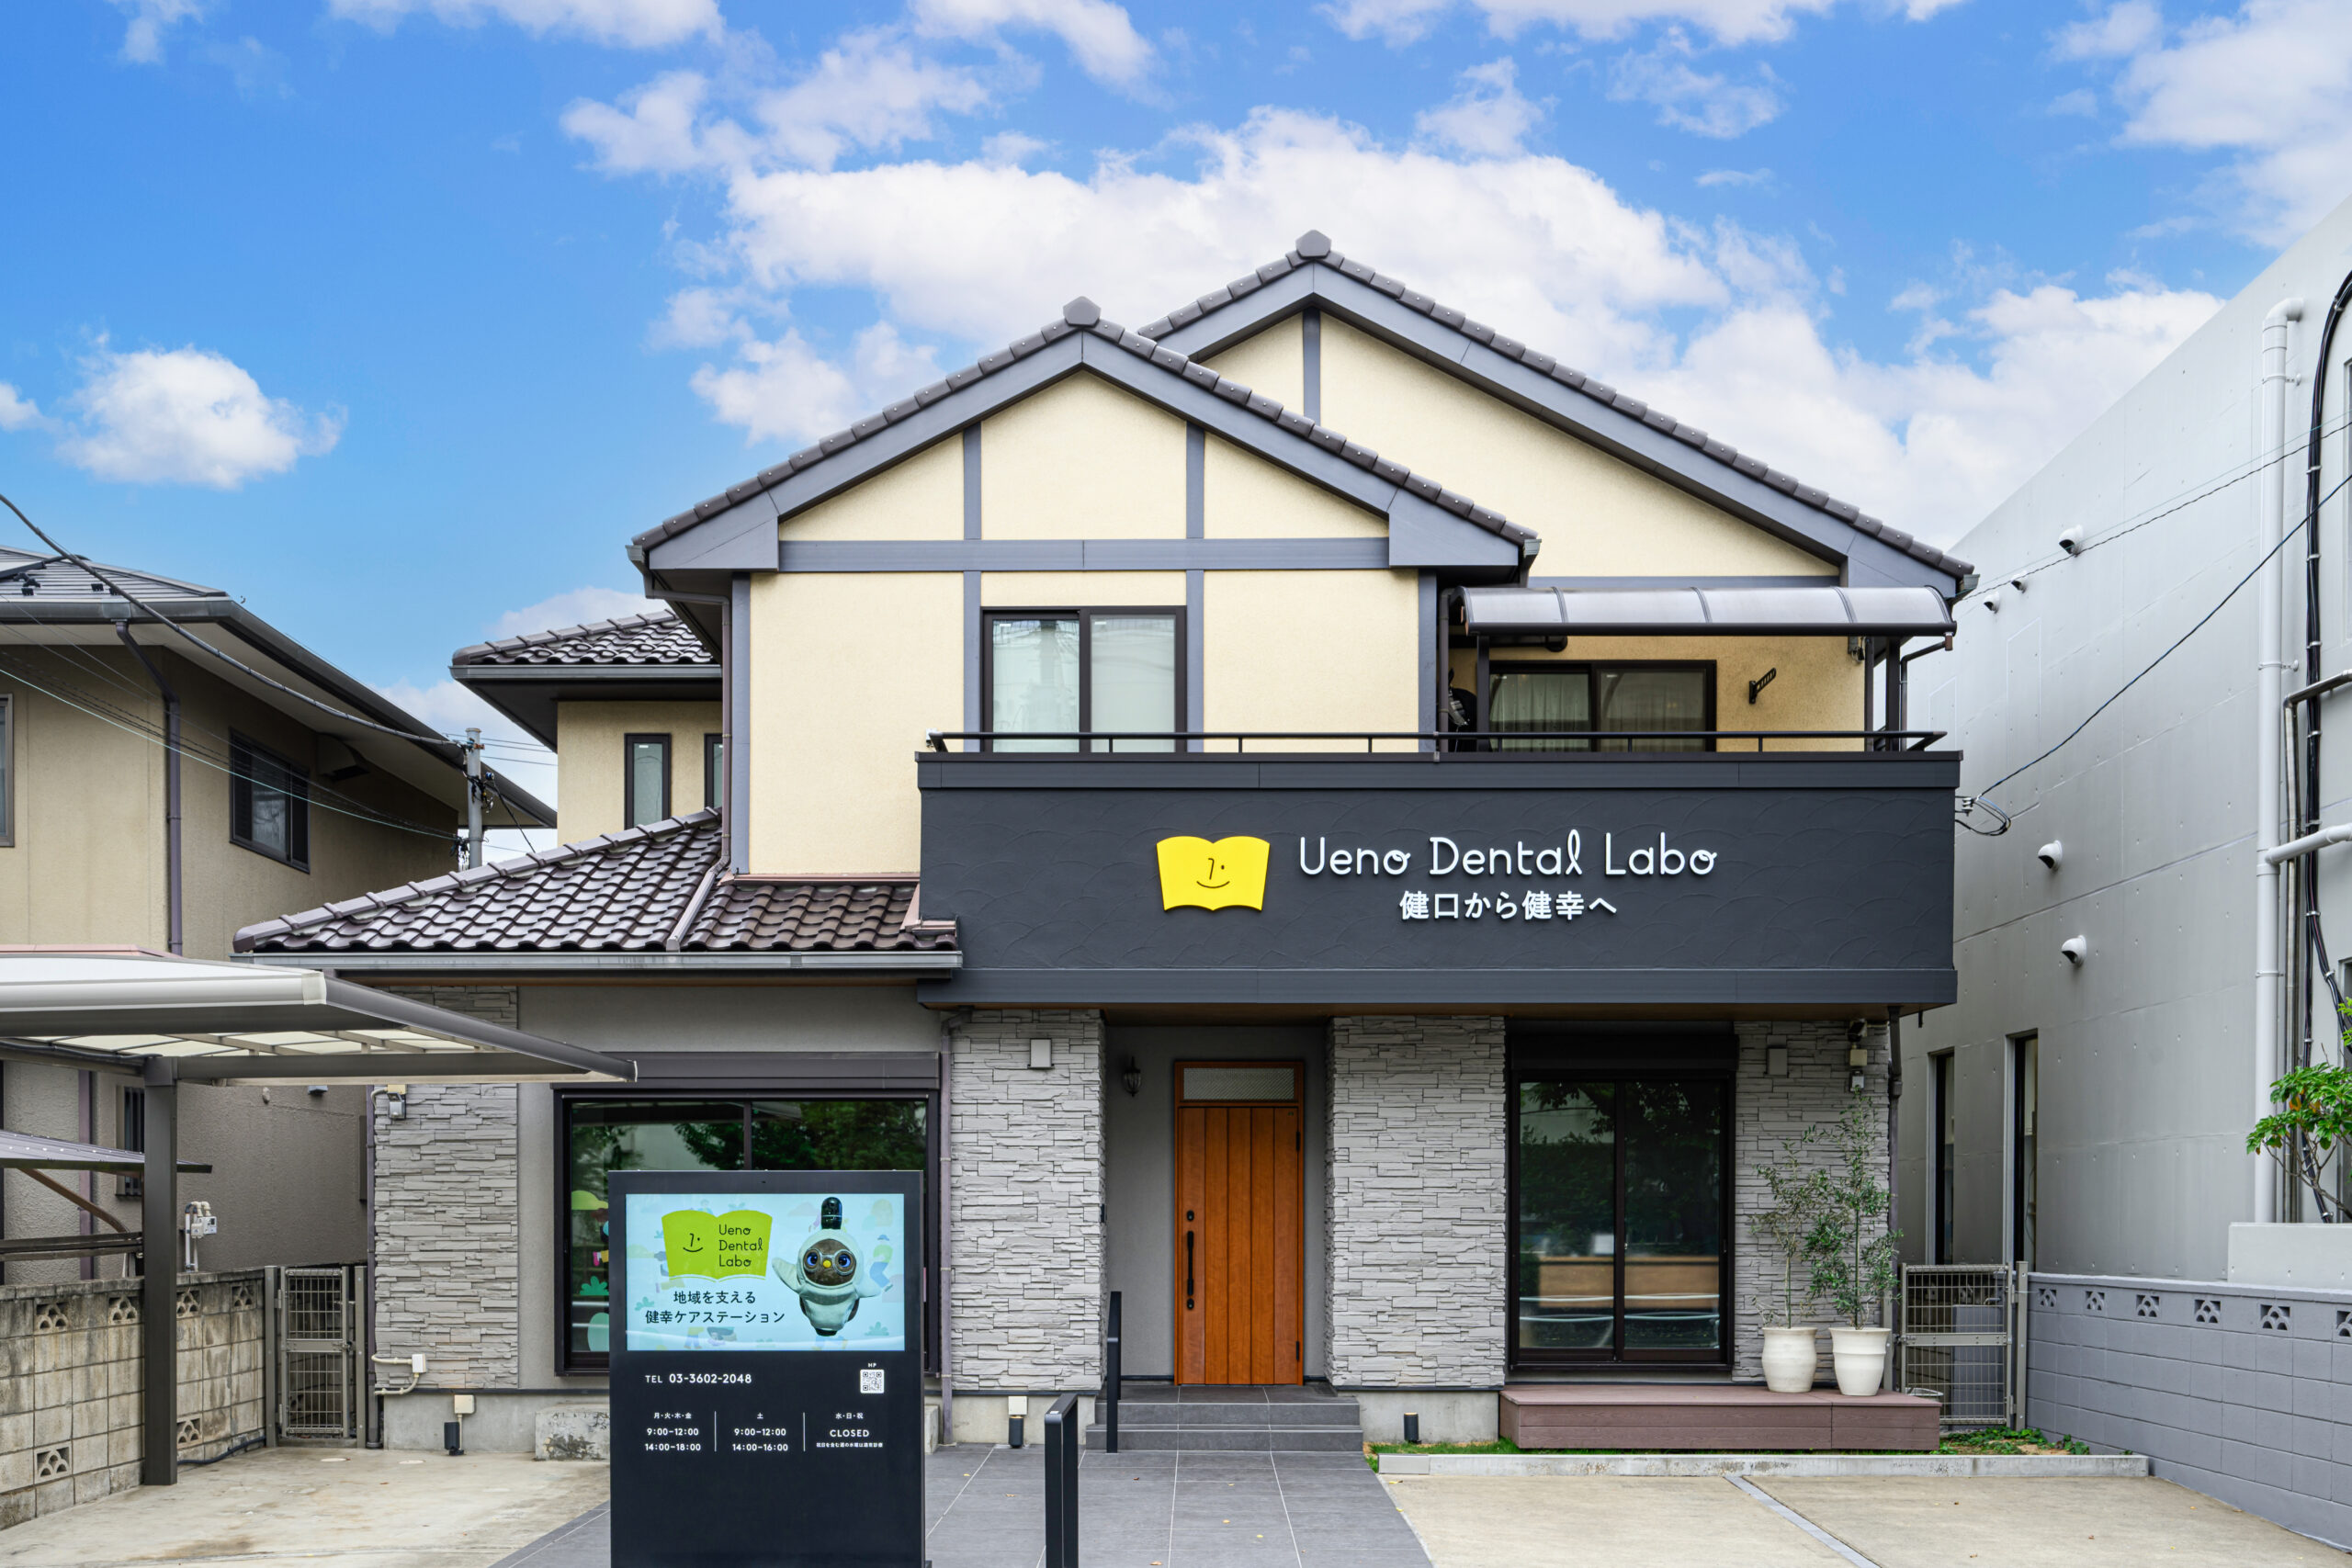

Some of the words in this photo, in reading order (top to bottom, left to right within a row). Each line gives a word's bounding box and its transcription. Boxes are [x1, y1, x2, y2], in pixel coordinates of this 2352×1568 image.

[1300, 837, 1411, 875] Ueno
[1429, 829, 1583, 875] Dental
[1605, 831, 1718, 875] Labo
[1398, 889, 1617, 920] 健口から健幸へ
[718, 1224, 752, 1235] Ueno
[718, 1236, 763, 1251] Dental
[718, 1254, 752, 1268] Labo
[673, 1290, 756, 1304] 地域を支える
[645, 1310, 786, 1325] 健幸ケアステーション
[645, 1374, 663, 1383] TEL
[669, 1373, 752, 1384] 03-3602-2048
[646, 1427, 699, 1437] 9:00-12:00
[733, 1427, 786, 1437] 9:00-12:00
[829, 1428, 870, 1438] CLOSED
[644, 1443, 701, 1451] 14:00-18:00
[732, 1443, 788, 1451] 14:00-16:00
